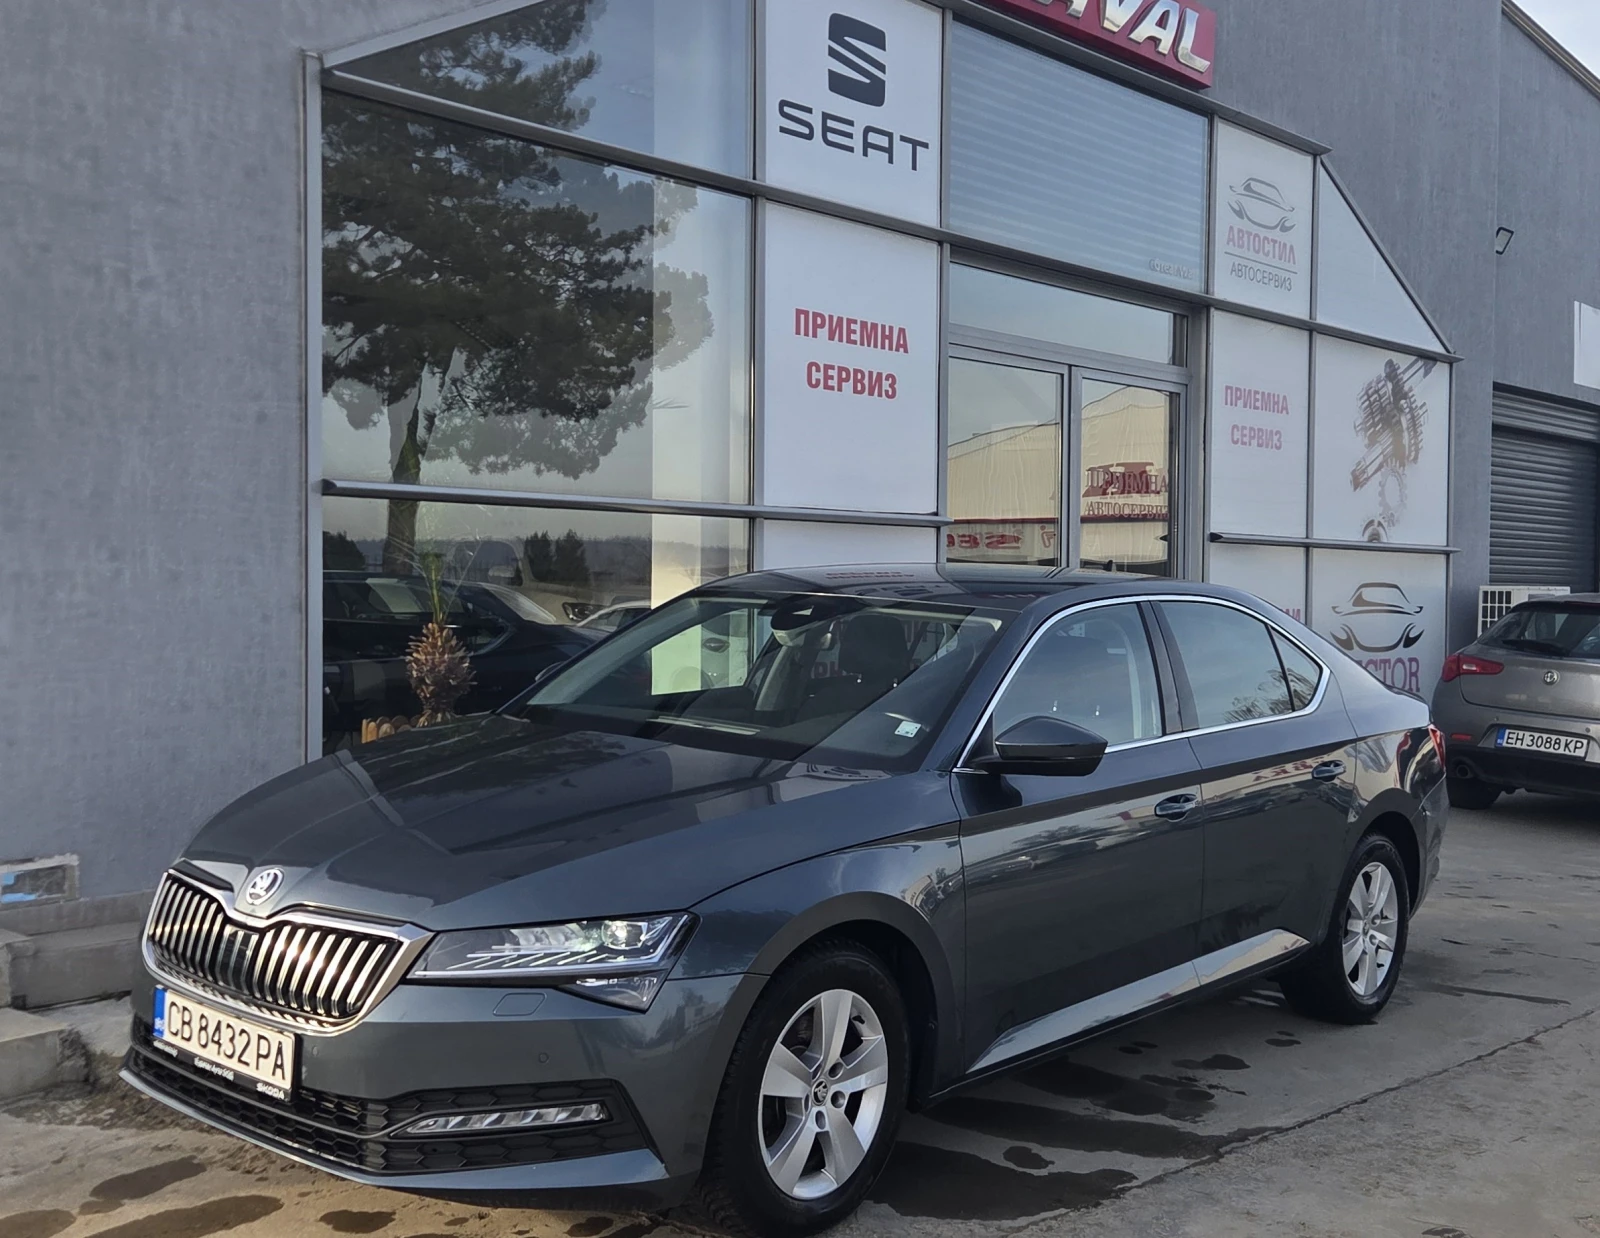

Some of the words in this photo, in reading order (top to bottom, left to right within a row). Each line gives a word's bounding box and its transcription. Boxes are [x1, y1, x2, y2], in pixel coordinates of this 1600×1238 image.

[778, 99, 930, 172] SEAT
[1226, 225, 1297, 265] АВТОСТИЛ
[1230, 263, 1293, 292] АВТОСЕРВИЗ
[794, 307, 910, 355] ПРИЕМНА
[806, 360, 898, 400] СЕРВИЗ
[1224, 384, 1290, 415] ПРИЕМНА
[1230, 423, 1283, 451] СЕРВИЗ
[1526, 733, 1562, 752] 3088
[168, 1001, 193, 1042] CB
[199, 1012, 251, 1068] 8432
[255, 1034, 287, 1081] PA
